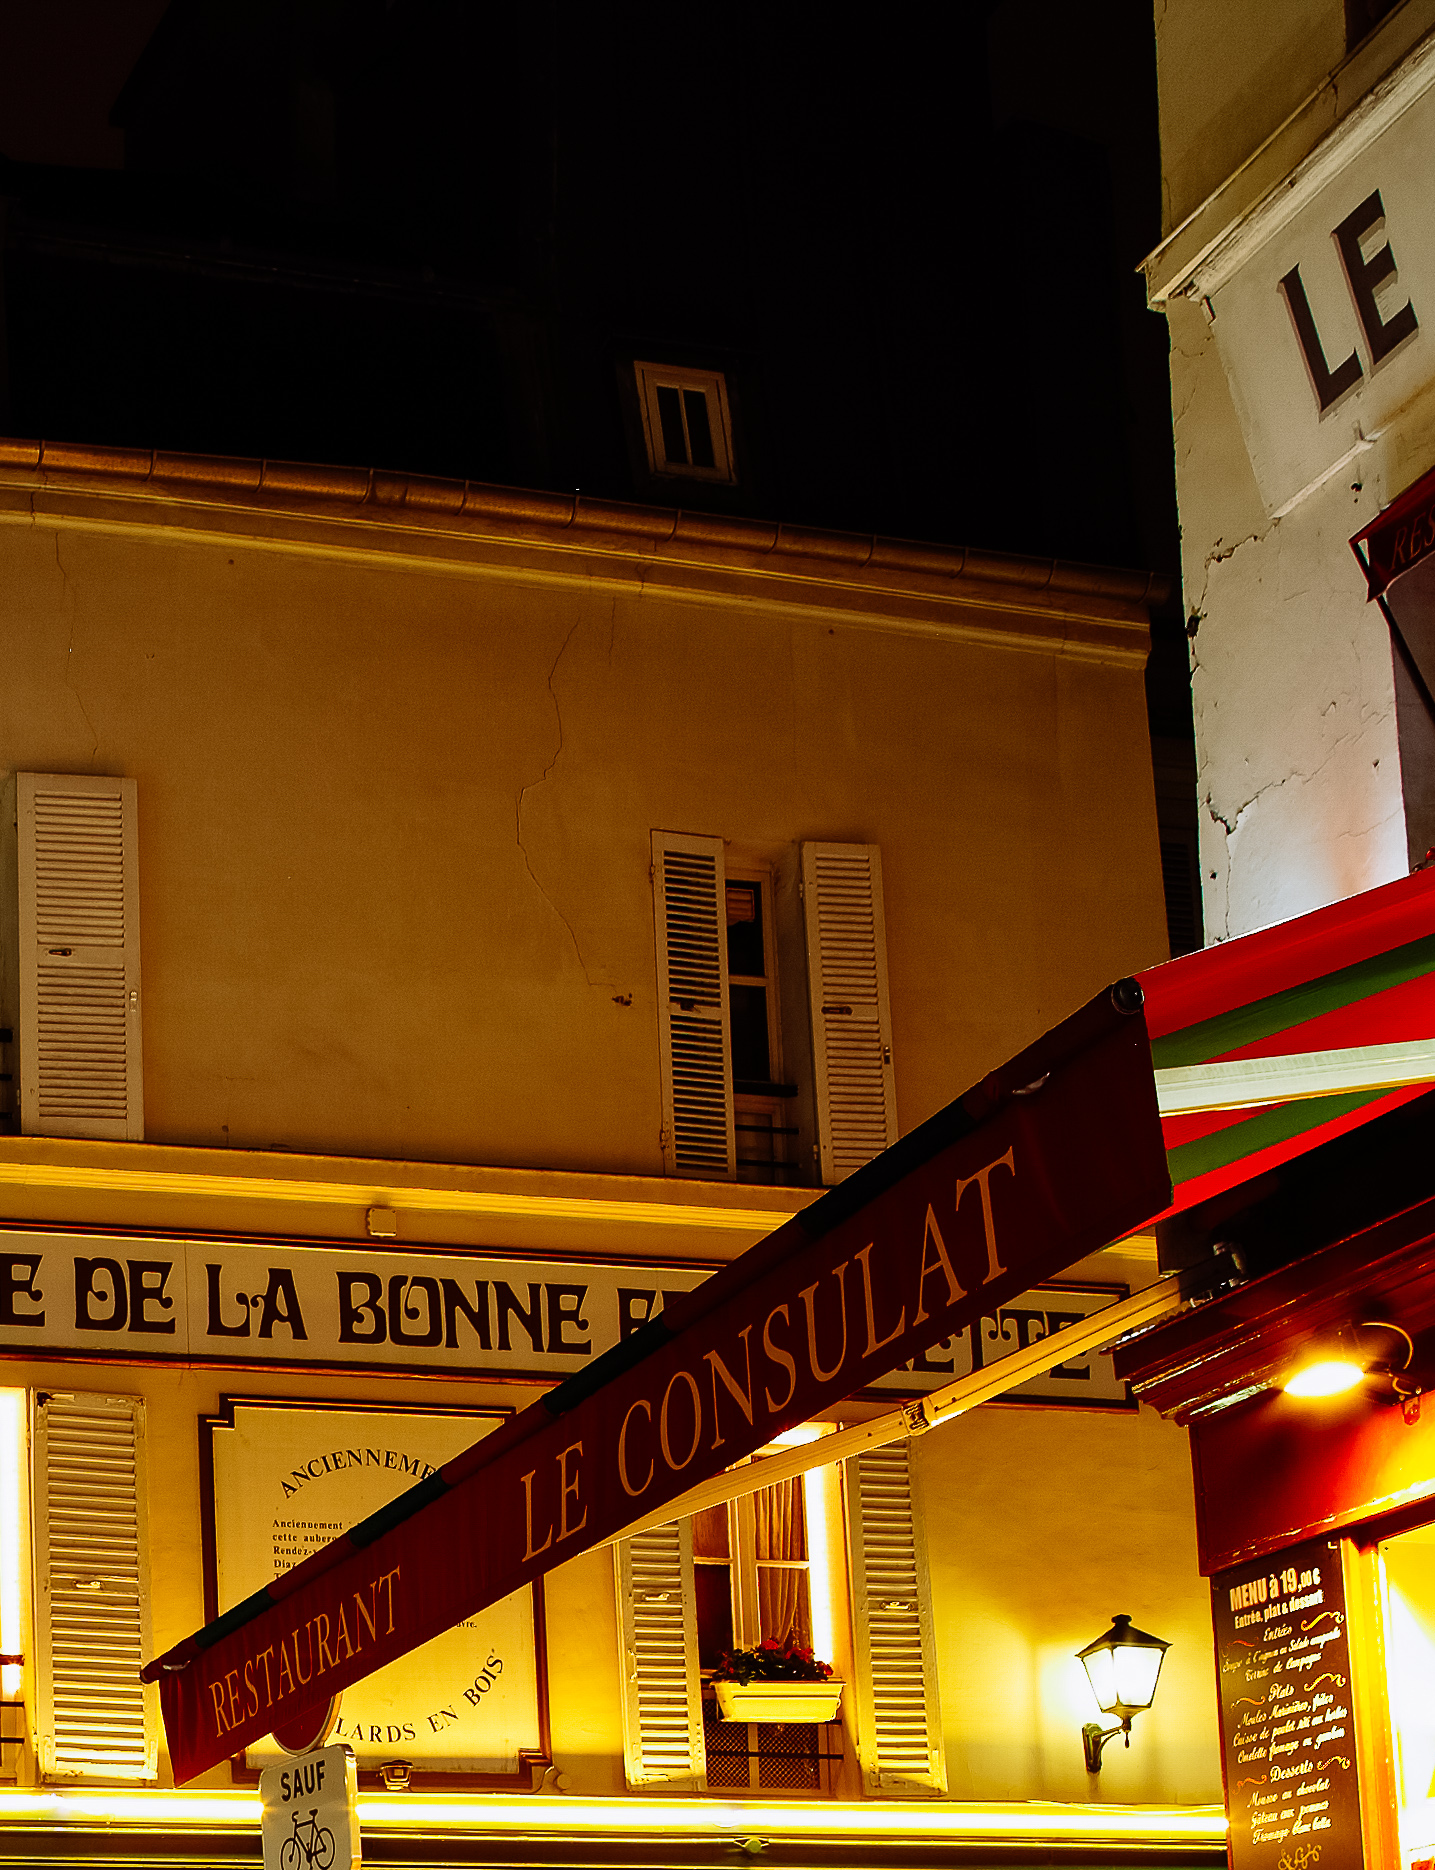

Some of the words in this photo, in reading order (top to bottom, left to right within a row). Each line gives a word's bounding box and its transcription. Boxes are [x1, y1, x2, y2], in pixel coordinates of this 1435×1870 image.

[1277, 188, 1419, 423] LE
[73, 1256, 177, 1335] DE
[205, 1262, 309, 1342] LA
[338, 1269, 593, 1357] BONNE
[207, 1564, 403, 1739] RESTAURANT
[520, 1440, 591, 1564] LE
[615, 1146, 1019, 1498] CONSULAT
[279, 1448, 437, 1500] ANCIENNEME
[1229, 1576, 1267, 1611] MENU
[1269, 1574, 1279, 1599] à
[1268, 1682, 1295, 1702] Plats
[335, 1718, 416, 1743] LARDS
[427, 1704, 459, 1734] EN
[281, 1760, 326, 1802] SAUF
[1270, 1759, 1314, 1783] Desserts
